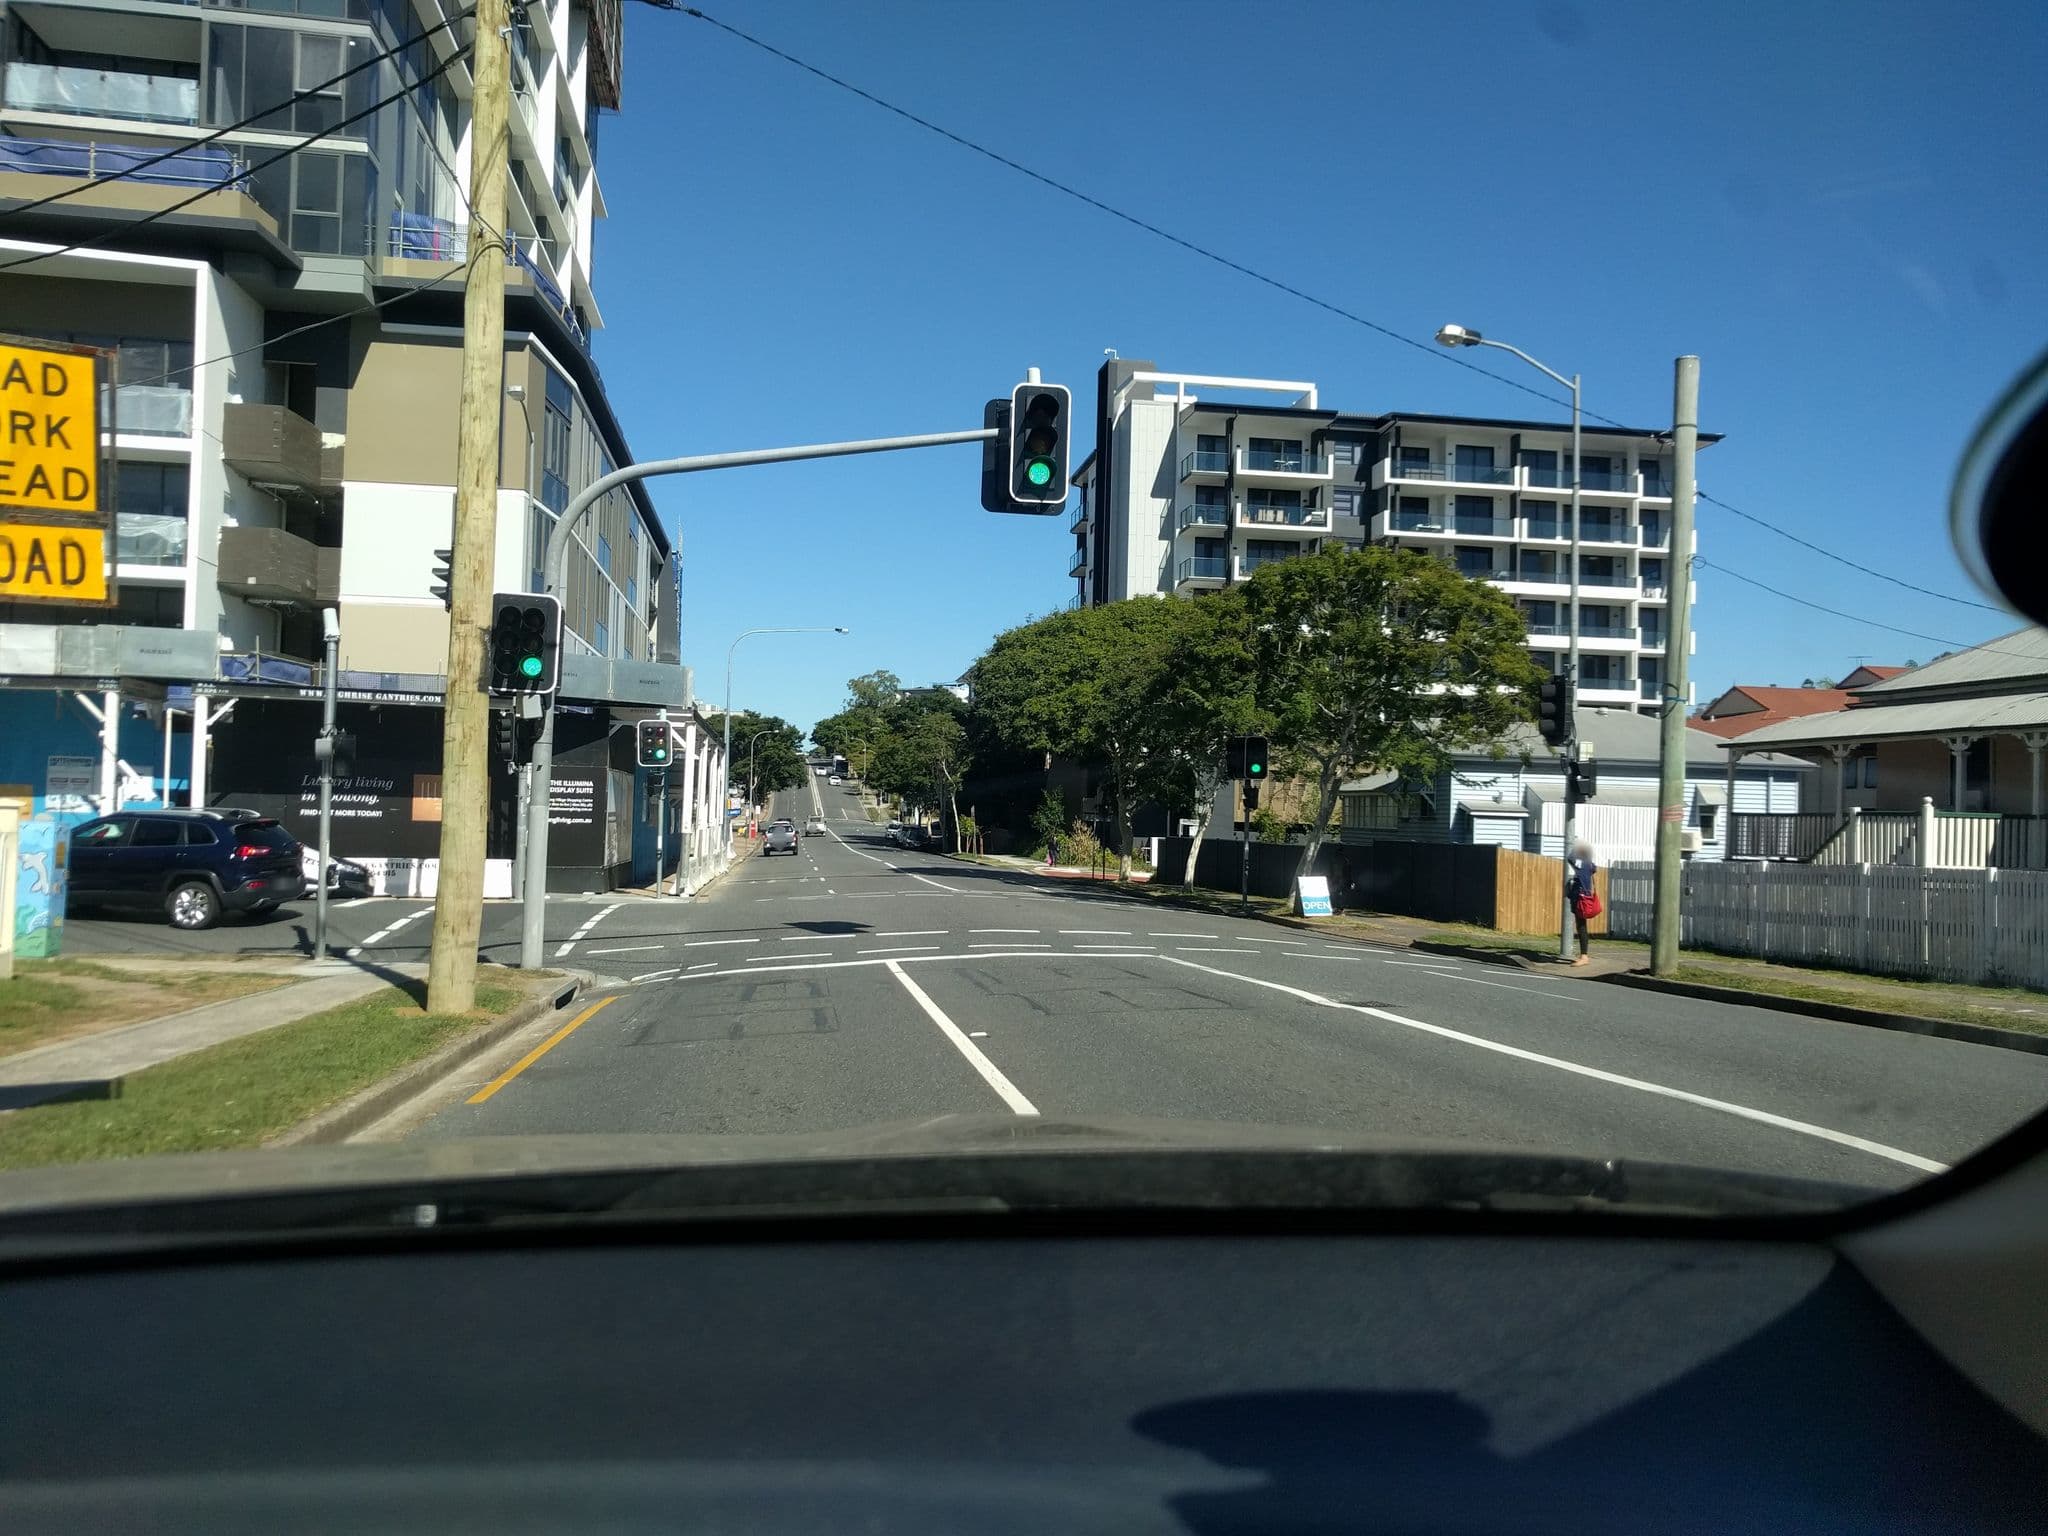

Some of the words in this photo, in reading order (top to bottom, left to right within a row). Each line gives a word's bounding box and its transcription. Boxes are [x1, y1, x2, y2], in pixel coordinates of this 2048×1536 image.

[0, 410, 72, 450] RK
[375, 692, 442, 703] GANTRIES.COM
[301, 775, 352, 789] Luury
[355, 776, 394, 791] living
[301, 790, 317, 801] in
[335, 809, 356, 817] MORE
[357, 810, 383, 818] TODAY!
[1303, 901, 1331, 910] OPEN
